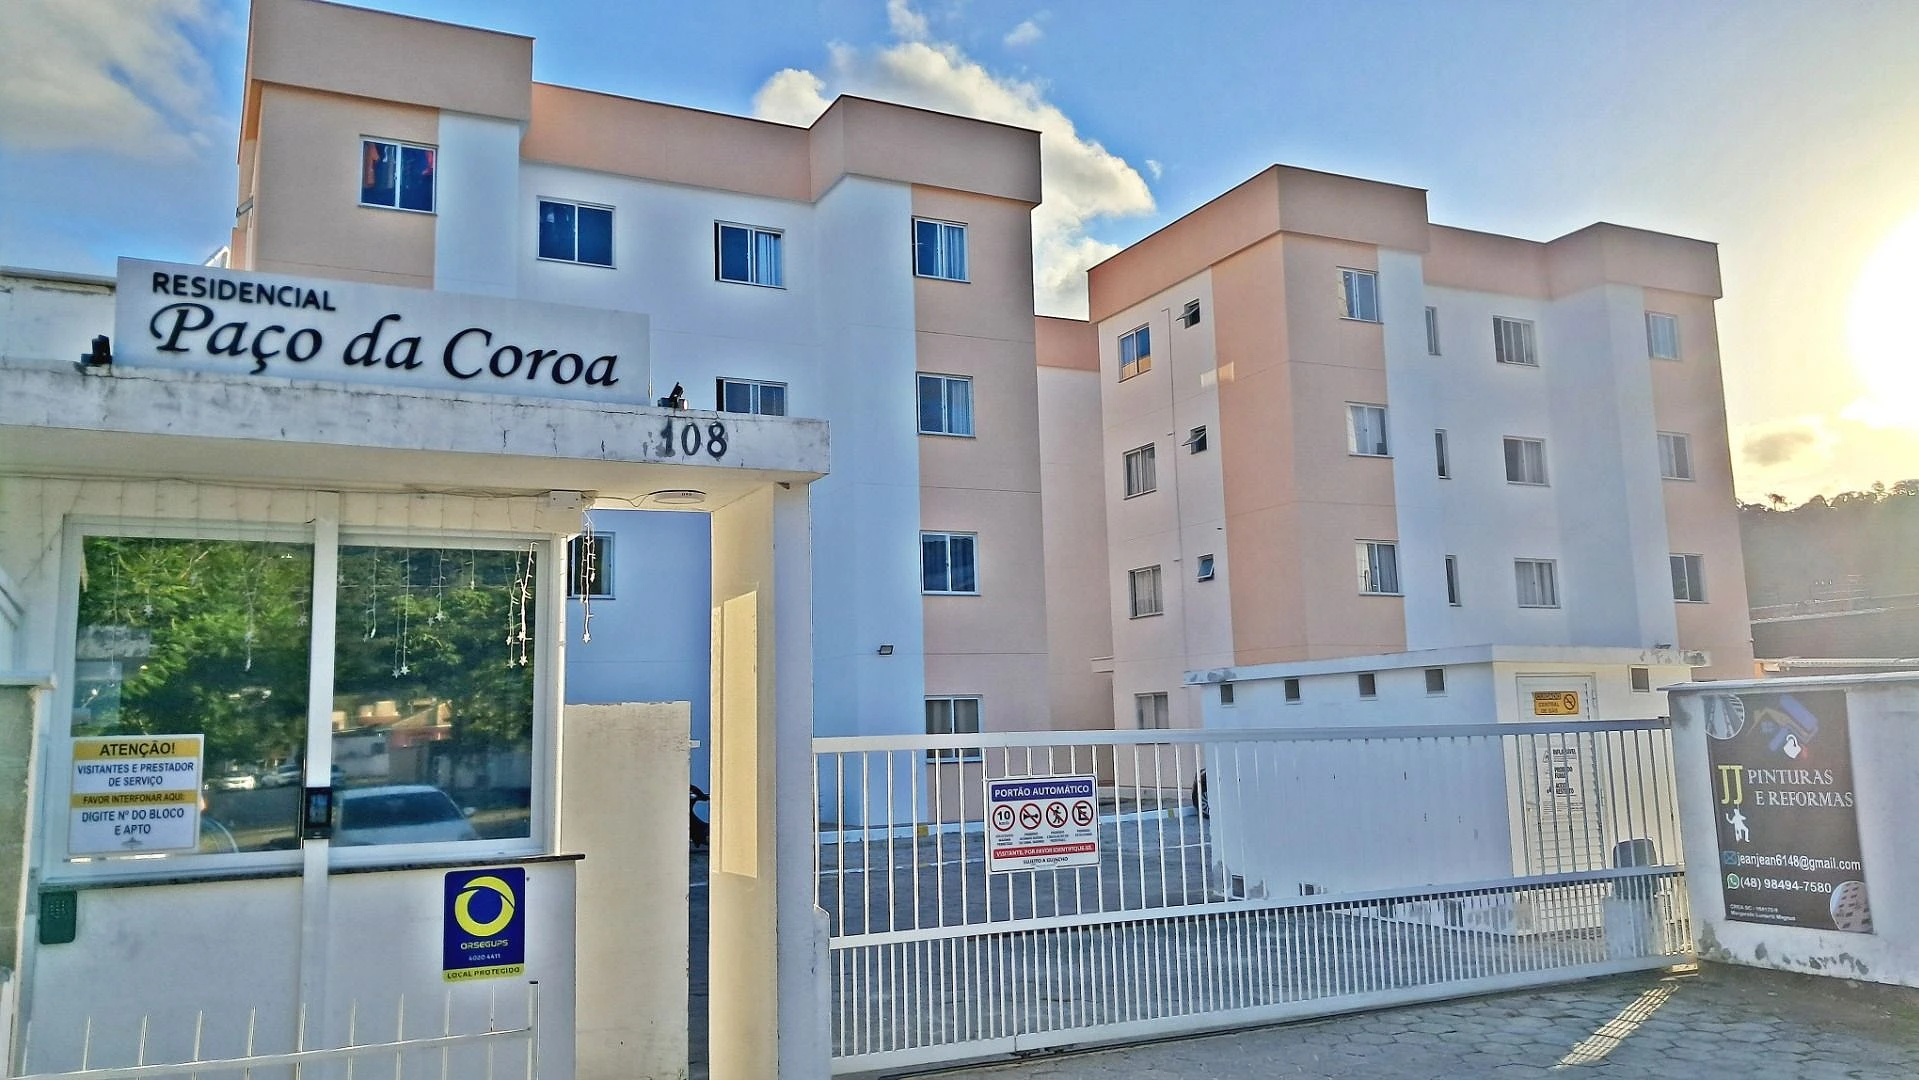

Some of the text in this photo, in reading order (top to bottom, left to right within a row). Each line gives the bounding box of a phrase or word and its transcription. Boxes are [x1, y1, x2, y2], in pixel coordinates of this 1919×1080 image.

[153, 271, 336, 312] RESIDENCIAL
[149, 302, 620, 387] Paço da Coroa
[660, 417, 728, 459] 108
[99, 740, 176, 758] ATENÇÃO!
[77, 762, 194, 775] VISITANTES E PRESTADOR
[108, 775, 163, 788] DE SERVIÇO
[1747, 768, 1834, 786] PINTURAS
[83, 795, 110, 804] FAVOR
[111, 793, 162, 803] INTERFONAR
[994, 784, 1090, 798] PORTÃO AUTOMÁTICO
[1756, 790, 1854, 808] E REFORMAS
[81, 810, 116, 822] DIGITE
[132, 809, 147, 820] DO
[149, 807, 185, 820] BLOCO
[997, 810, 1011, 821] 10
[114, 824, 151, 836] E APTO
[1736, 852, 1861, 871] jeanjean6148@gmail.com
[1740, 876, 1832, 894] (48) 98494-7580
[447, 966, 520, 979] LOCAL PROTEGIDO
